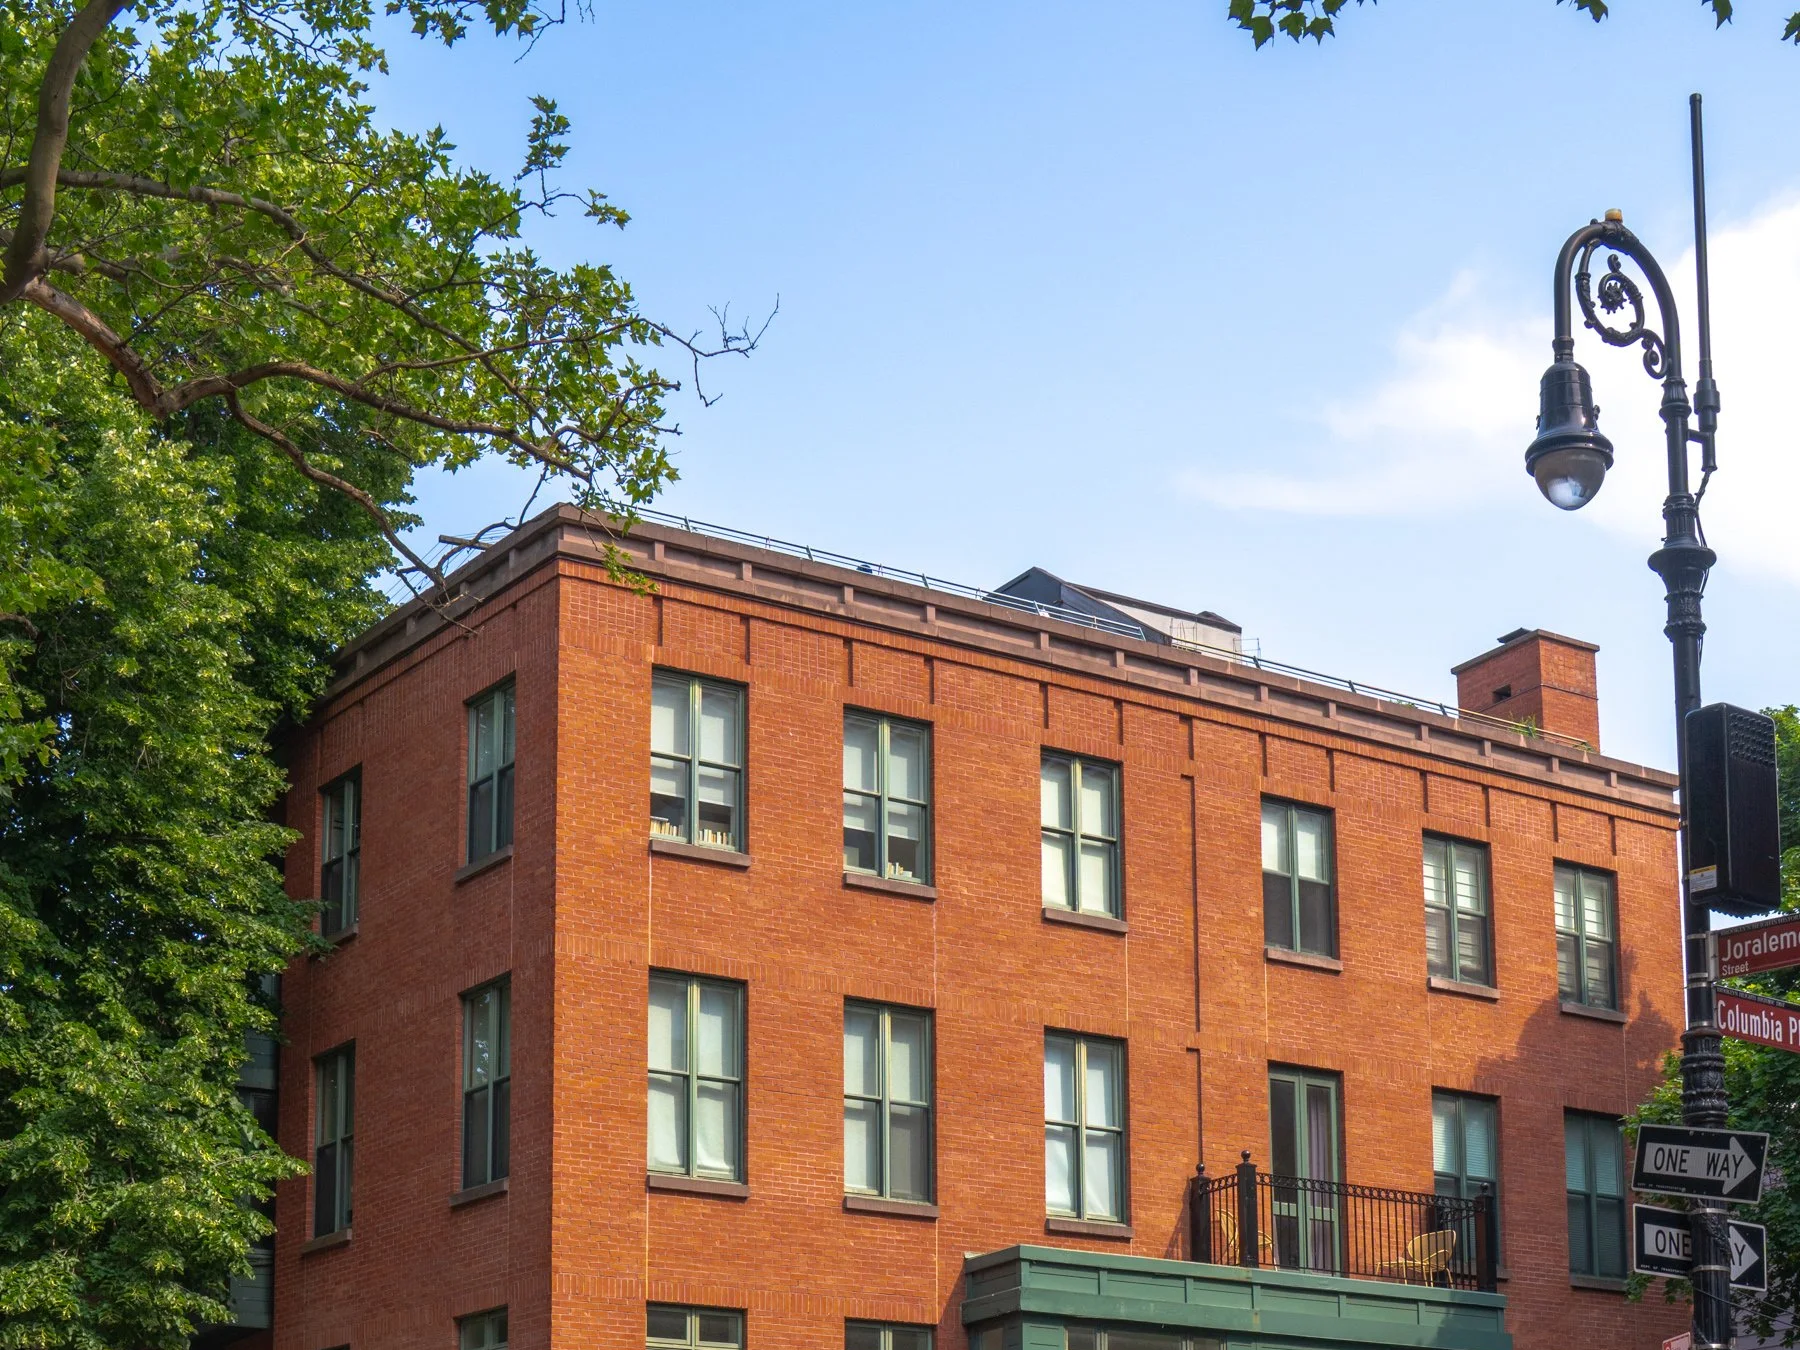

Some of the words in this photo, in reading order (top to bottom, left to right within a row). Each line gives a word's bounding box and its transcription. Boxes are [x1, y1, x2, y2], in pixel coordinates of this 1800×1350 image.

[1722, 961, 1749, 976] Street
[1717, 1000, 1783, 1042] Columbia
[1654, 1147, 1690, 1174] ONE
[1706, 1151, 1745, 1179] WAY
[1655, 1229, 1692, 1258] ONE
